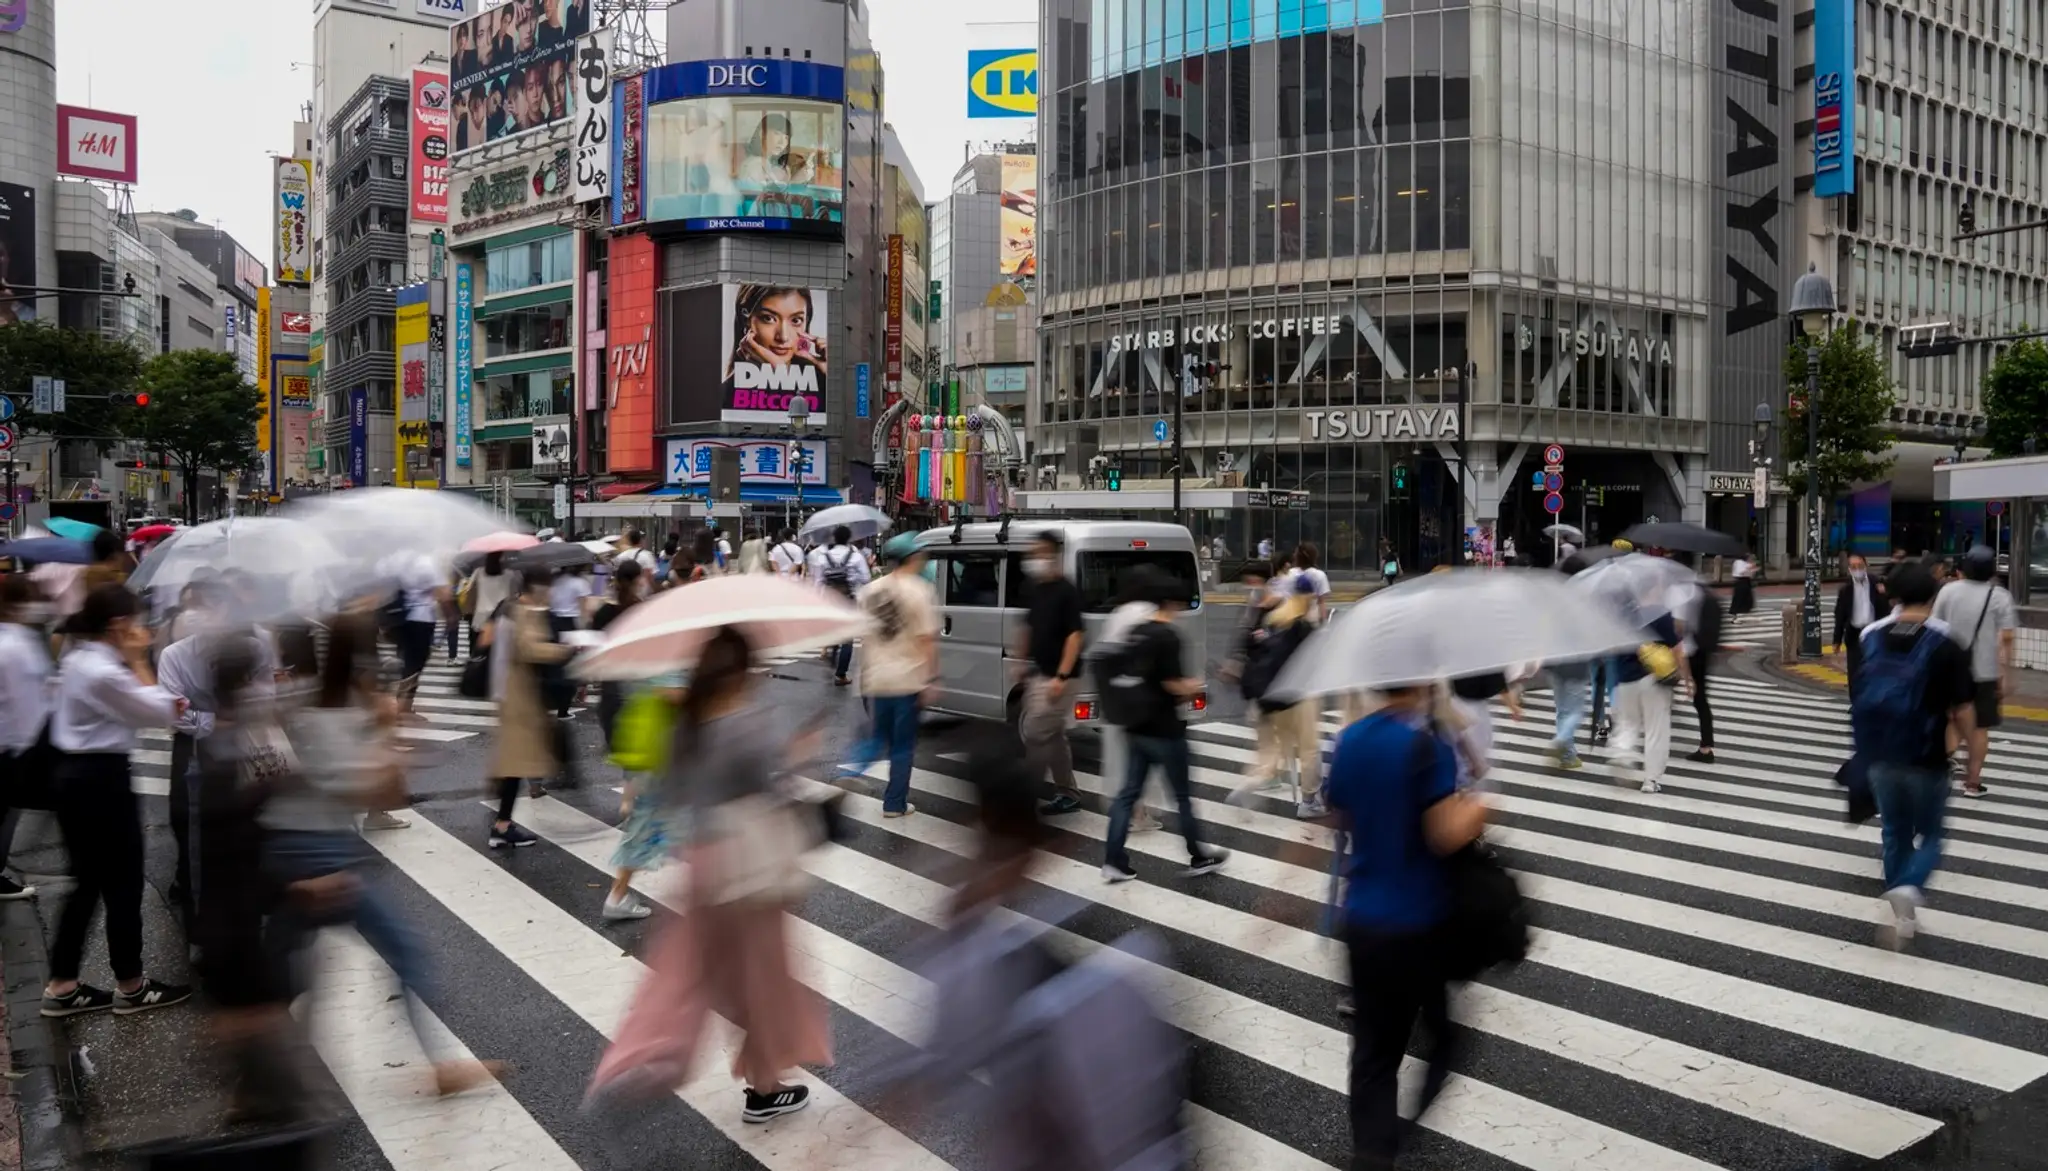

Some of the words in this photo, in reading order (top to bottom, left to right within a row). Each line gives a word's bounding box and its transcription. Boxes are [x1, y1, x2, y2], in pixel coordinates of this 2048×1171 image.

[708, 65, 768, 87] DHC
[577, 35, 609, 194] もんじゃ
[1816, 72, 1841, 174] SEIBU
[78, 132, 118, 158] H&M
[709, 219, 728, 228] DHC
[729, 219, 765, 228] Channel
[458, 290, 470, 392] サマーフルーツギフト
[1111, 323, 1236, 354] STARBUCKS
[1248, 315, 1341, 340] COFFEE
[1557, 326, 1673, 365] TSUTAYA
[403, 359, 426, 398] 薬
[610, 324, 652, 409] クスリ
[734, 361, 819, 392] DMM
[733, 389, 819, 411] Bitcon
[1306, 409, 1459, 438] TSUTAYA
[1710, 475, 1754, 490] TSUTAYA
